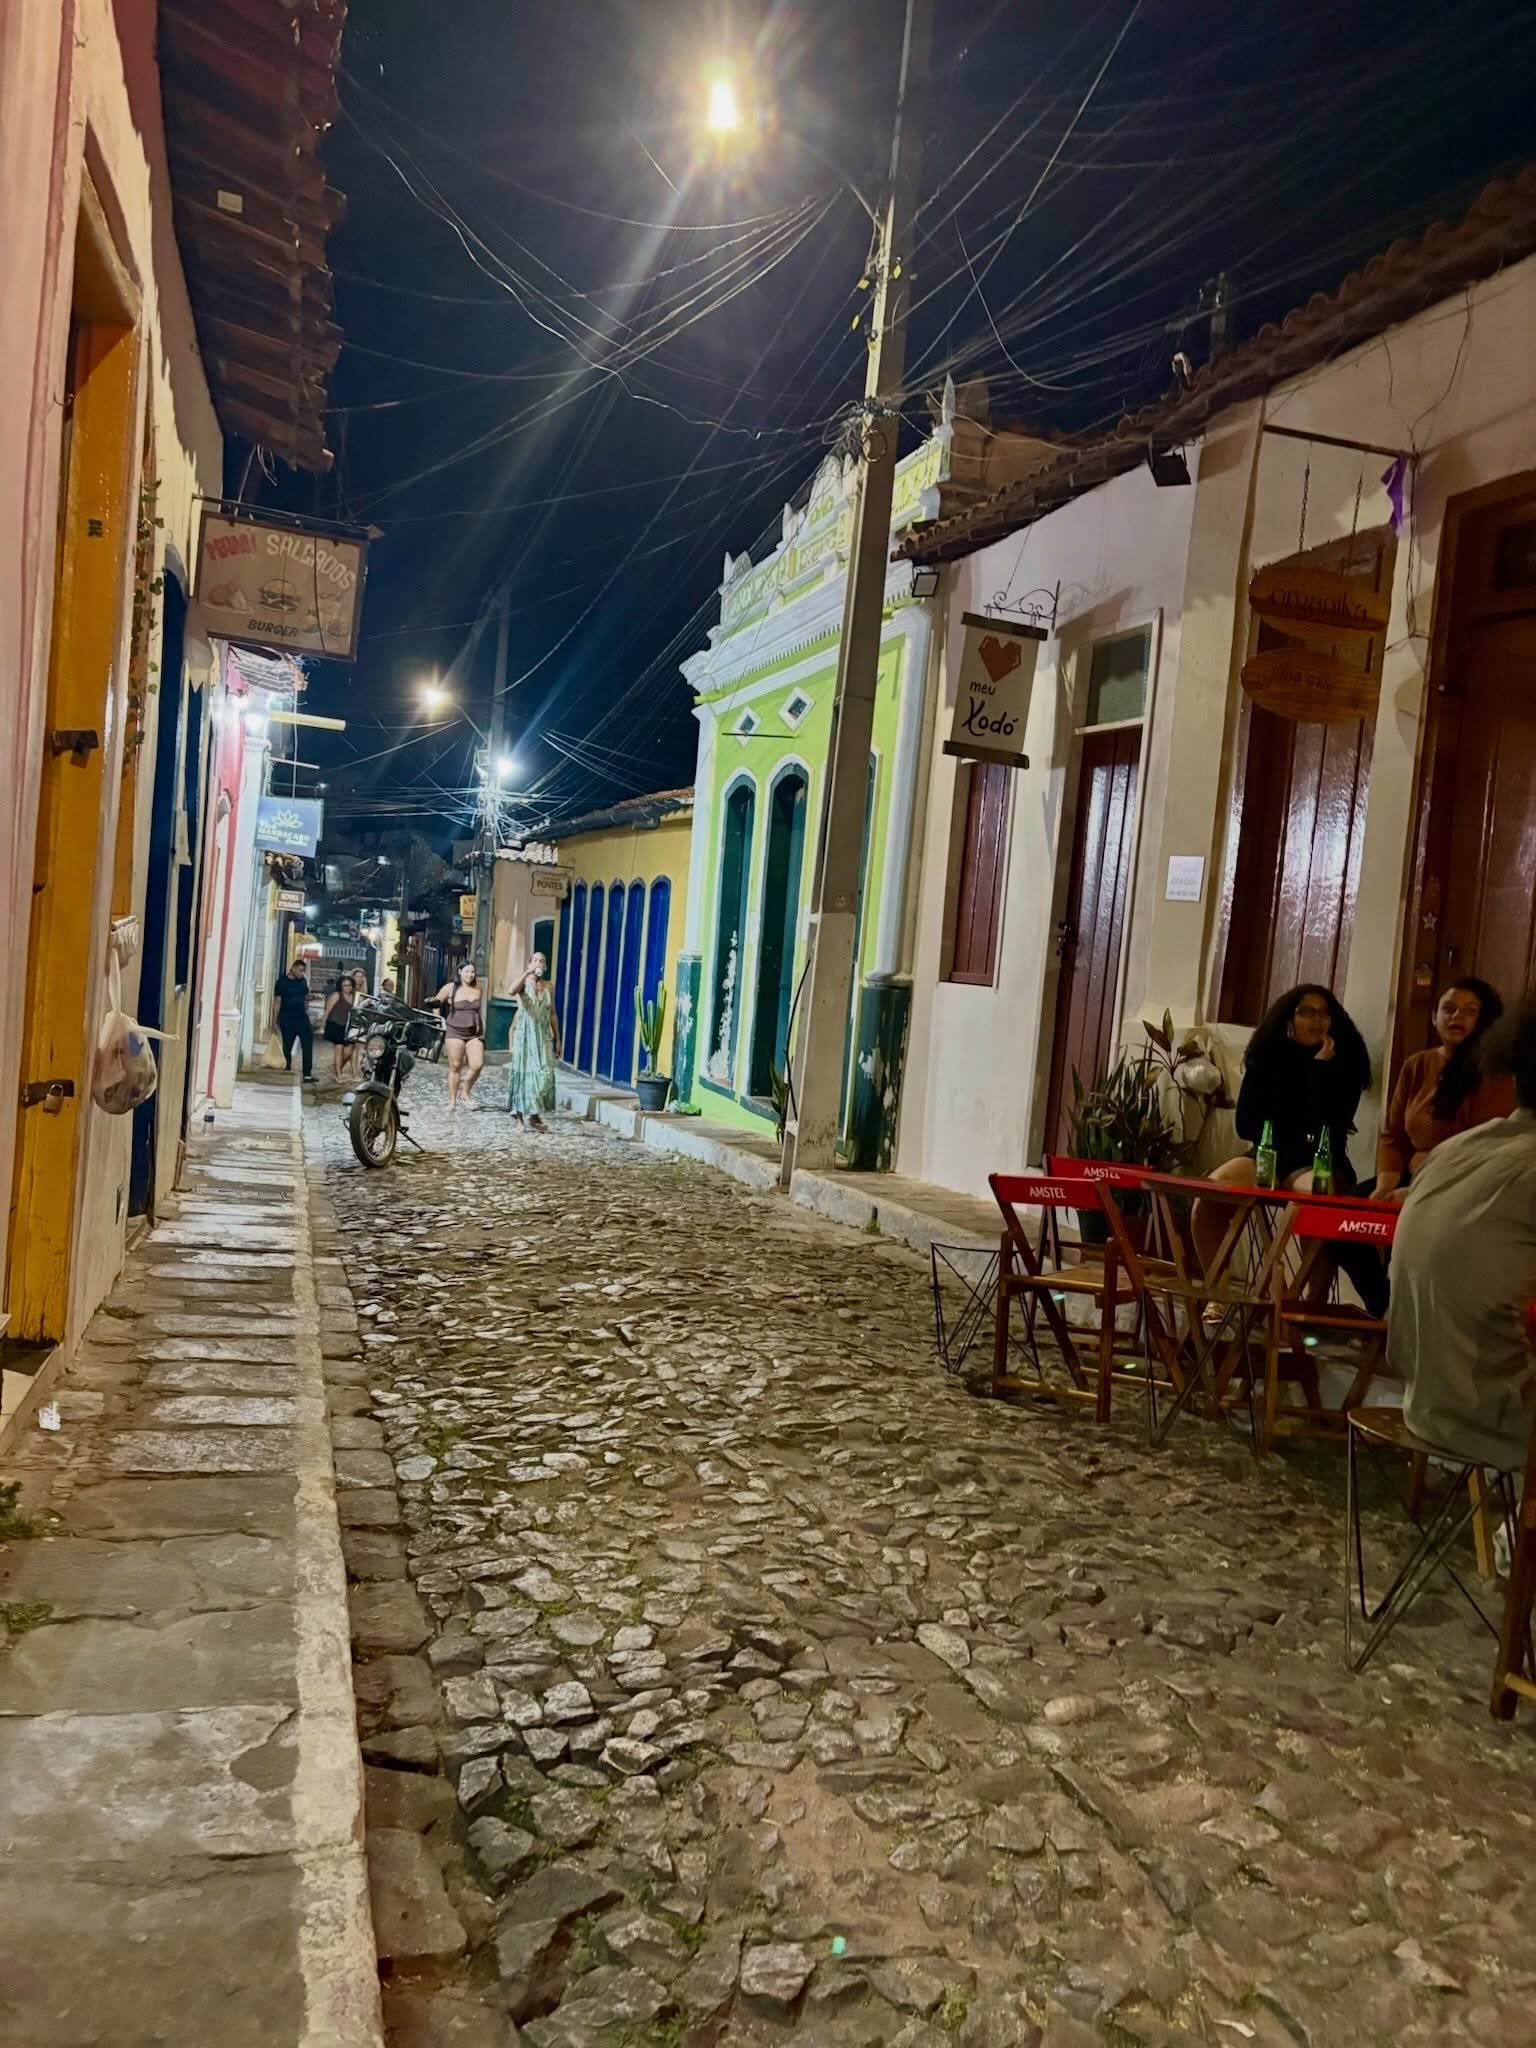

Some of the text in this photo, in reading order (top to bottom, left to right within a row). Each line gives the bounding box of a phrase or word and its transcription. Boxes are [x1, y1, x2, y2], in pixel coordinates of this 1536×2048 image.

[266, 534, 356, 589] SALGADOS
[247, 619, 298, 638] BURGER
[969, 681, 996, 696] meu
[961, 696, 1019, 737] Xodó
[536, 879, 564, 890] PONTES
[1029, 1186, 1067, 1199] AMSTEL
[1337, 1219, 1388, 1236] AMSTEL
